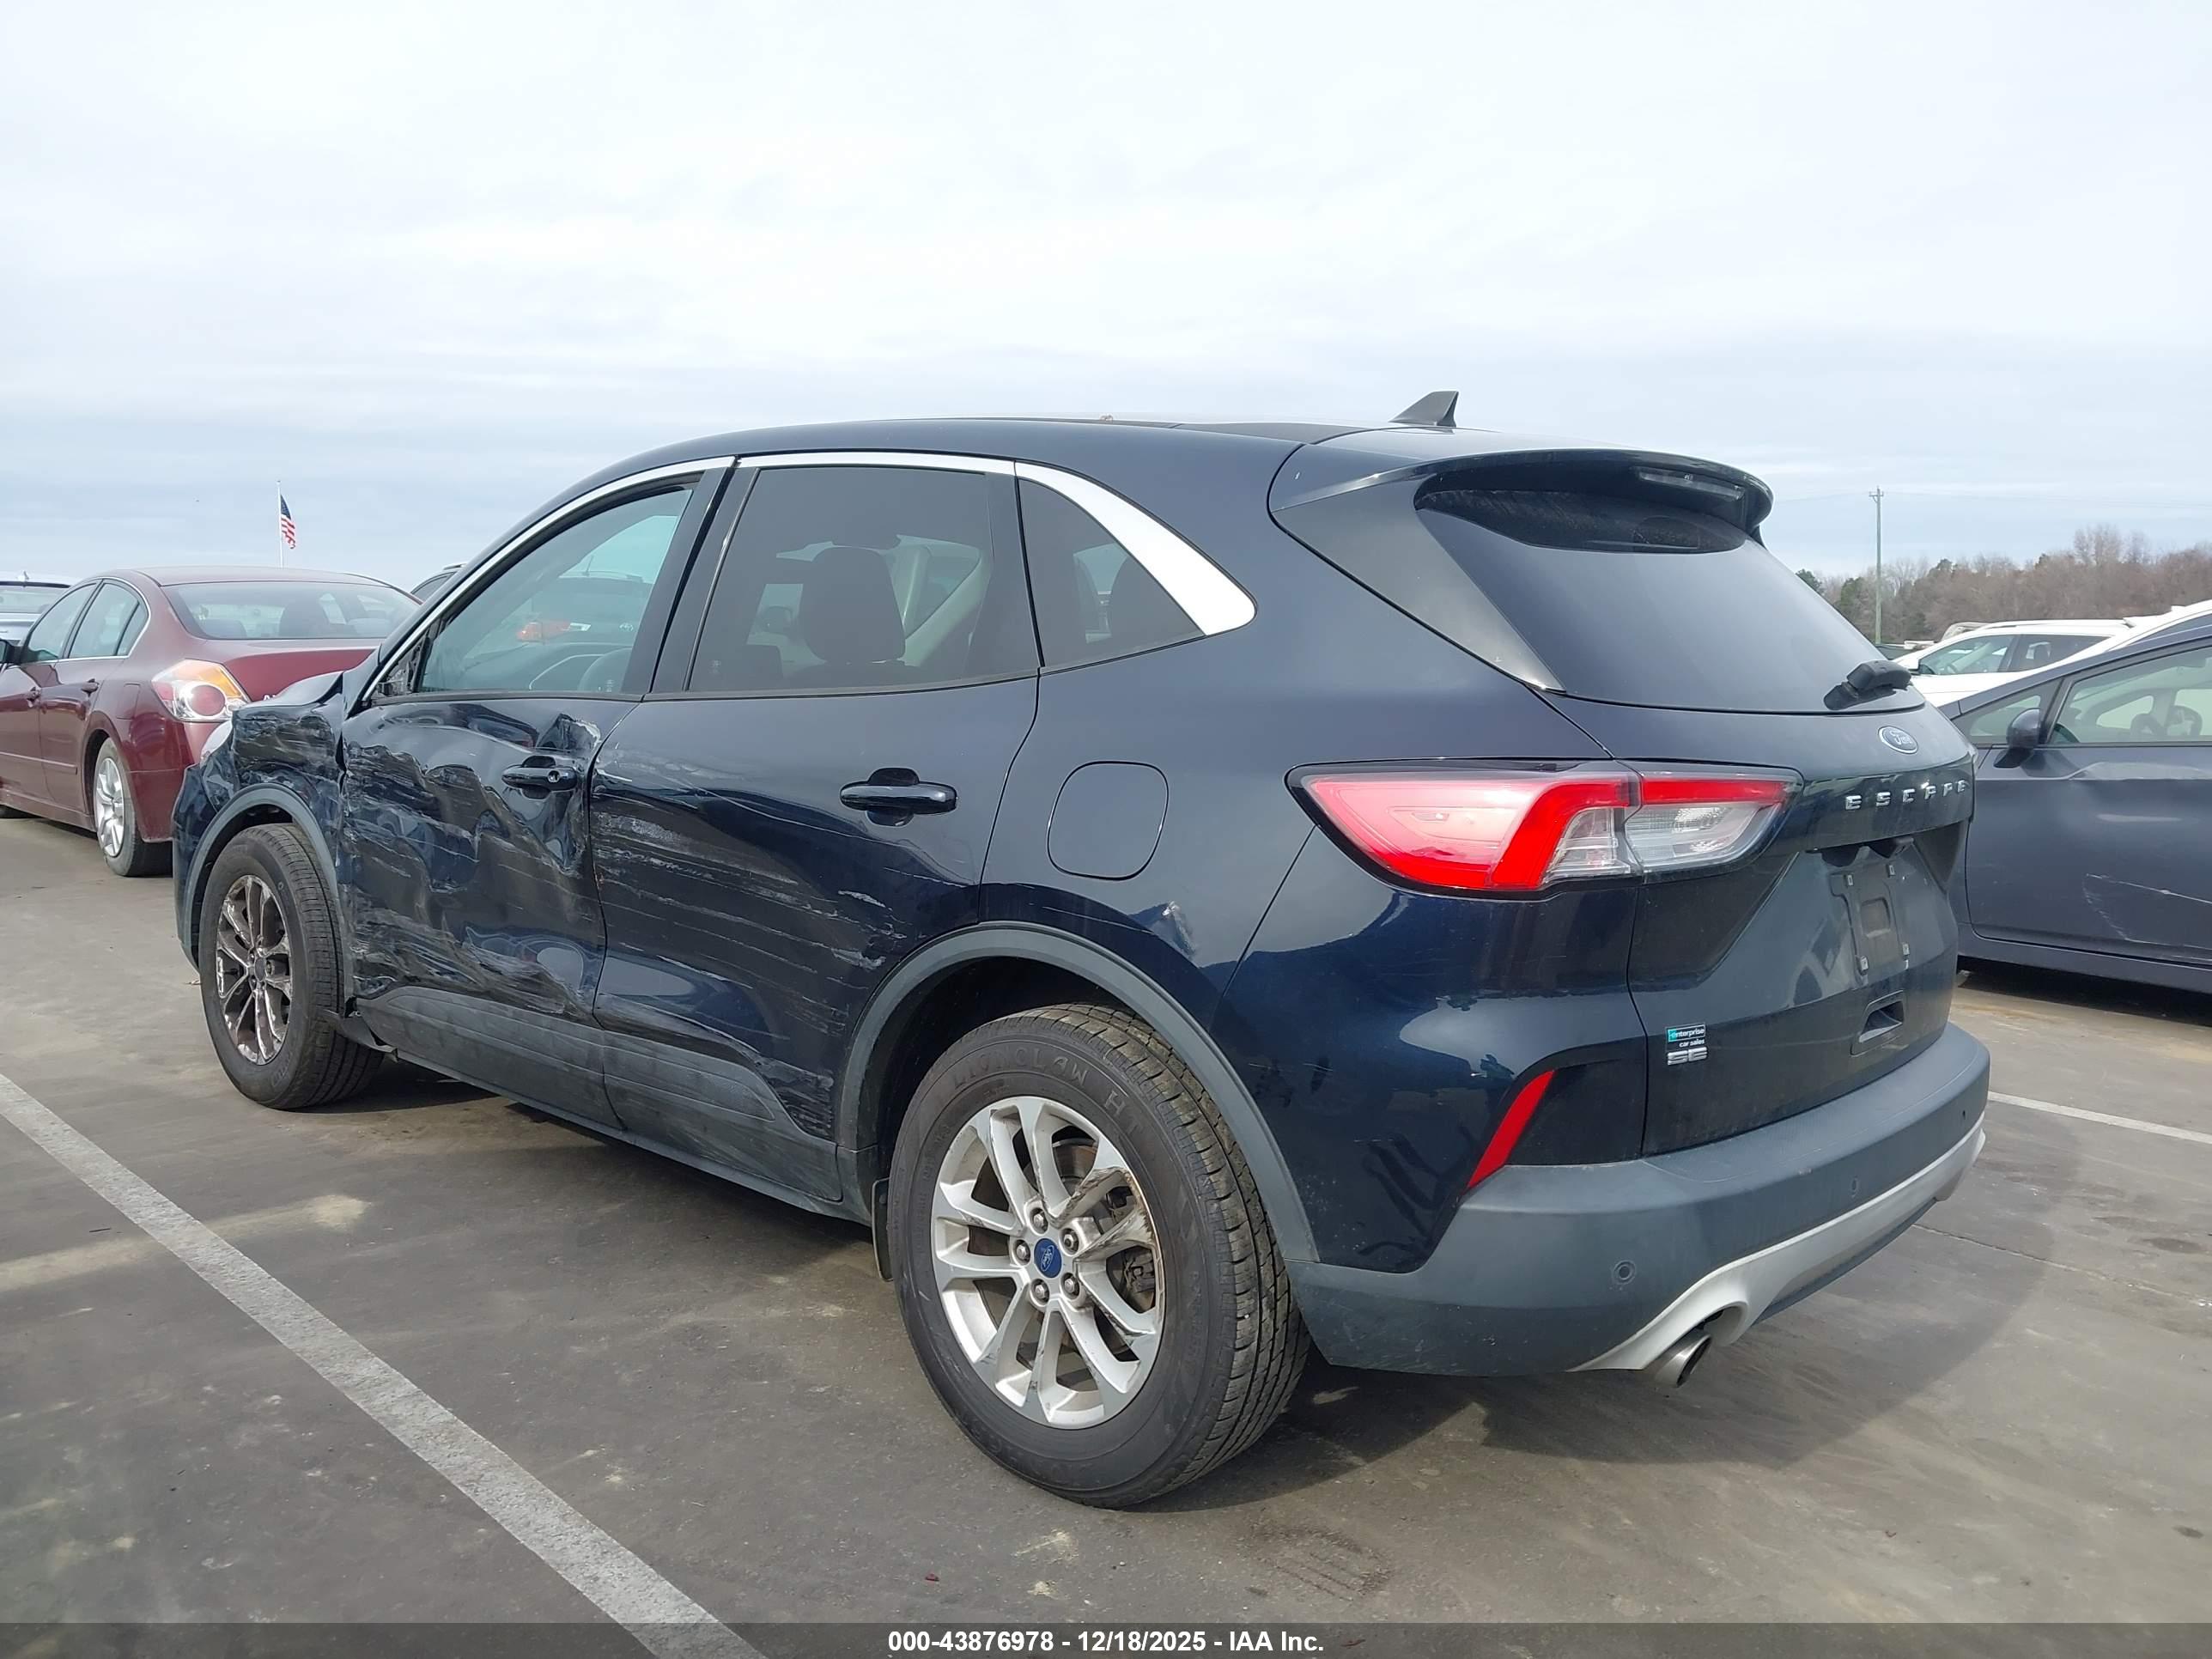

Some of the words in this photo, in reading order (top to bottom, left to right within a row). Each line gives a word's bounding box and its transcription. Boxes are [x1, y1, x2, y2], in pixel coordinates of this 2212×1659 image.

[1844, 779, 1967, 811] ESCAPE
[1670, 1028, 1705, 1038] enterprise
[1668, 1047, 1707, 1065] SE
